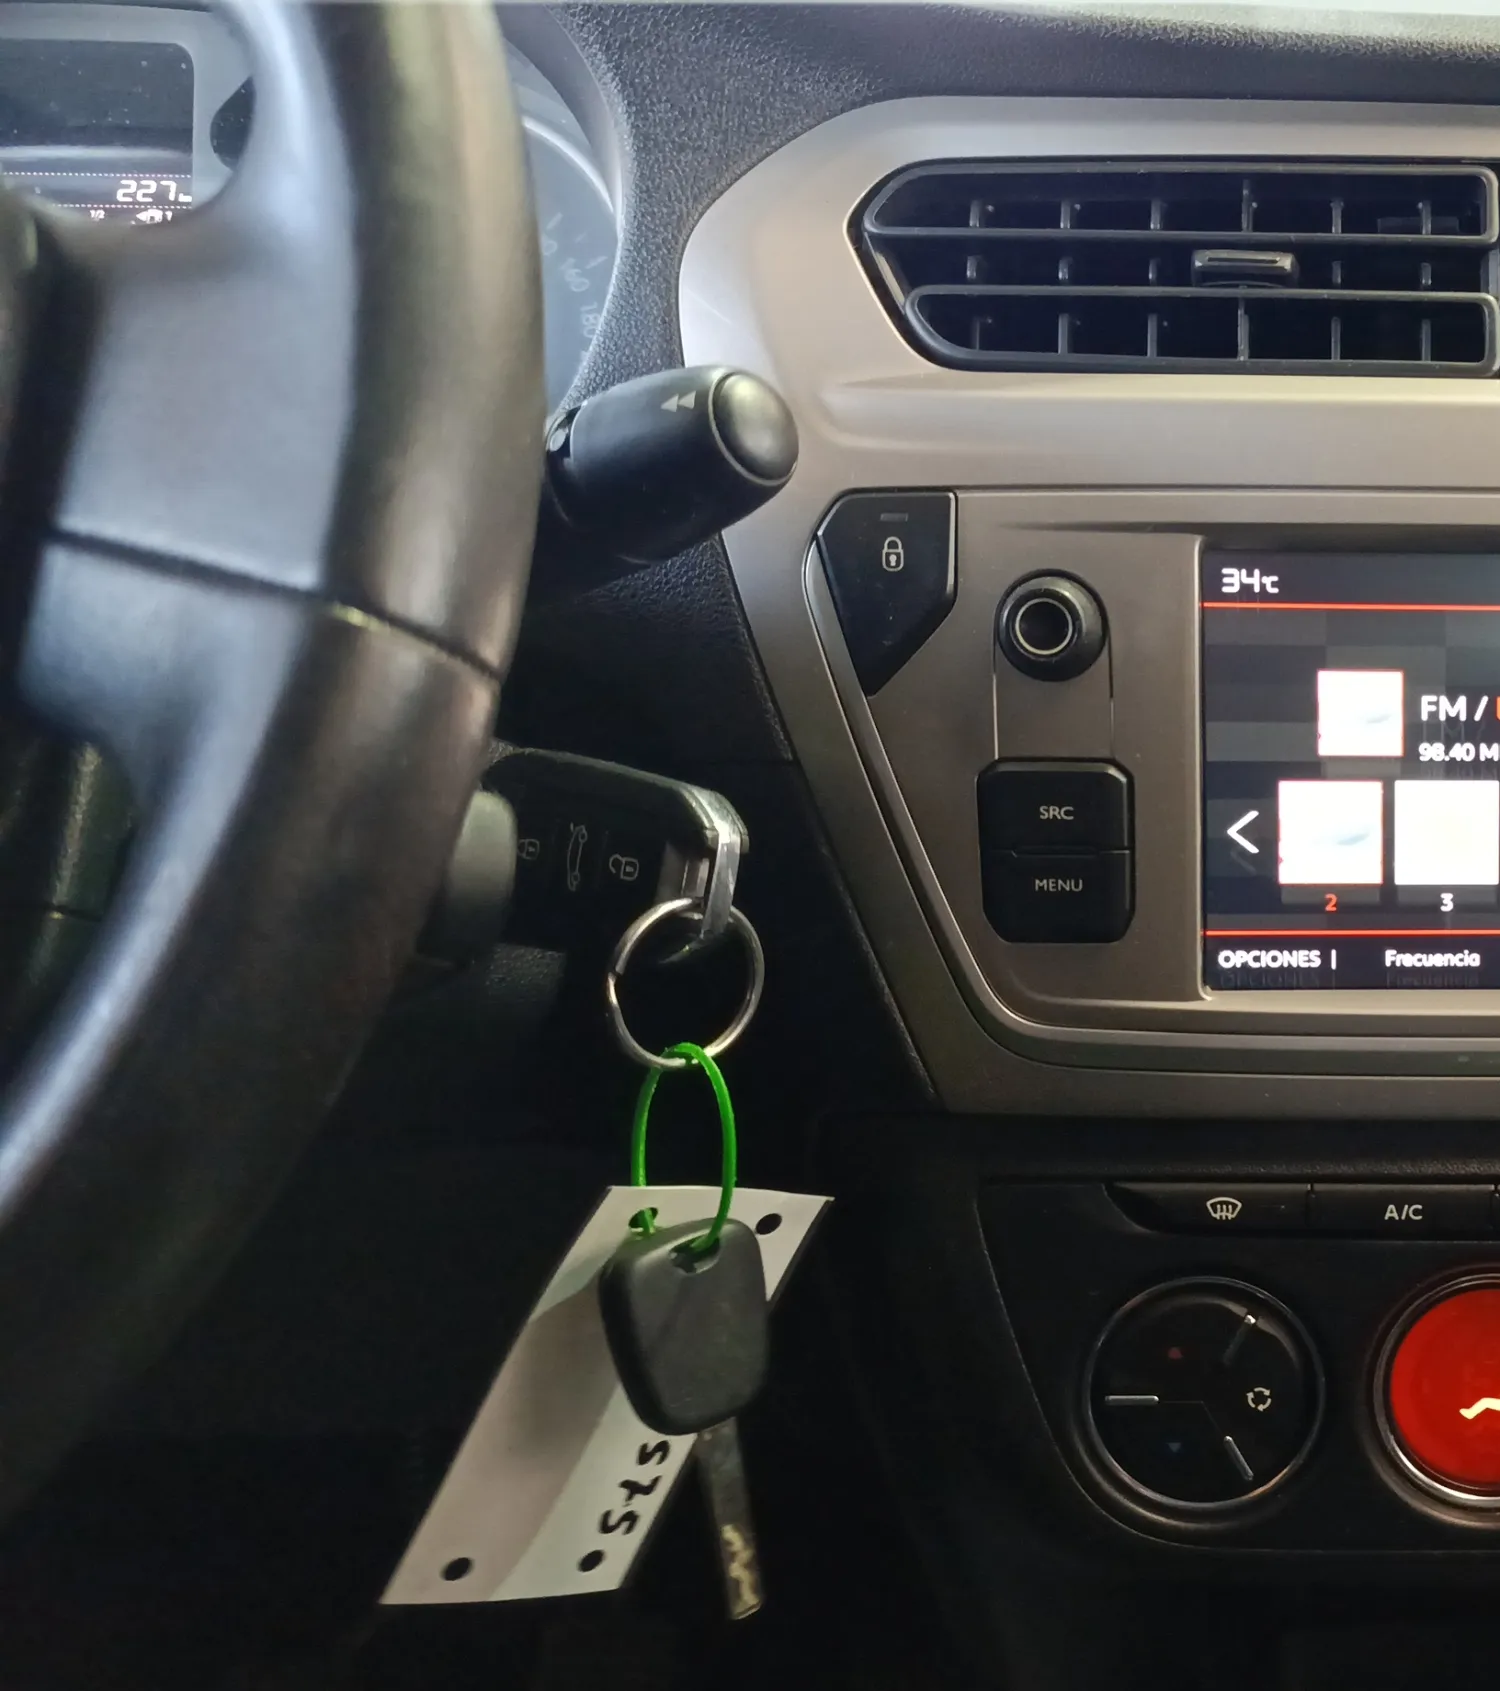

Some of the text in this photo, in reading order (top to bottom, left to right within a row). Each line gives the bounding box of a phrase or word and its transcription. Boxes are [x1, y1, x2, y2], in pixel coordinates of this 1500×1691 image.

[116, 179, 178, 203] 227
[1420, 695, 1467, 722] FM
[1474, 695, 1489, 722] /
[1418, 742, 1476, 762] 98.40
[1039, 805, 1074, 820] SRC
[1034, 878, 1083, 892] MENU
[1325, 892, 1338, 912] 2
[1440, 892, 1454, 912] 3
[1217, 948, 1322, 969] OPCIONES
[1384, 949, 1481, 969] Frecuencia
[1384, 1203, 1424, 1221] A/C
